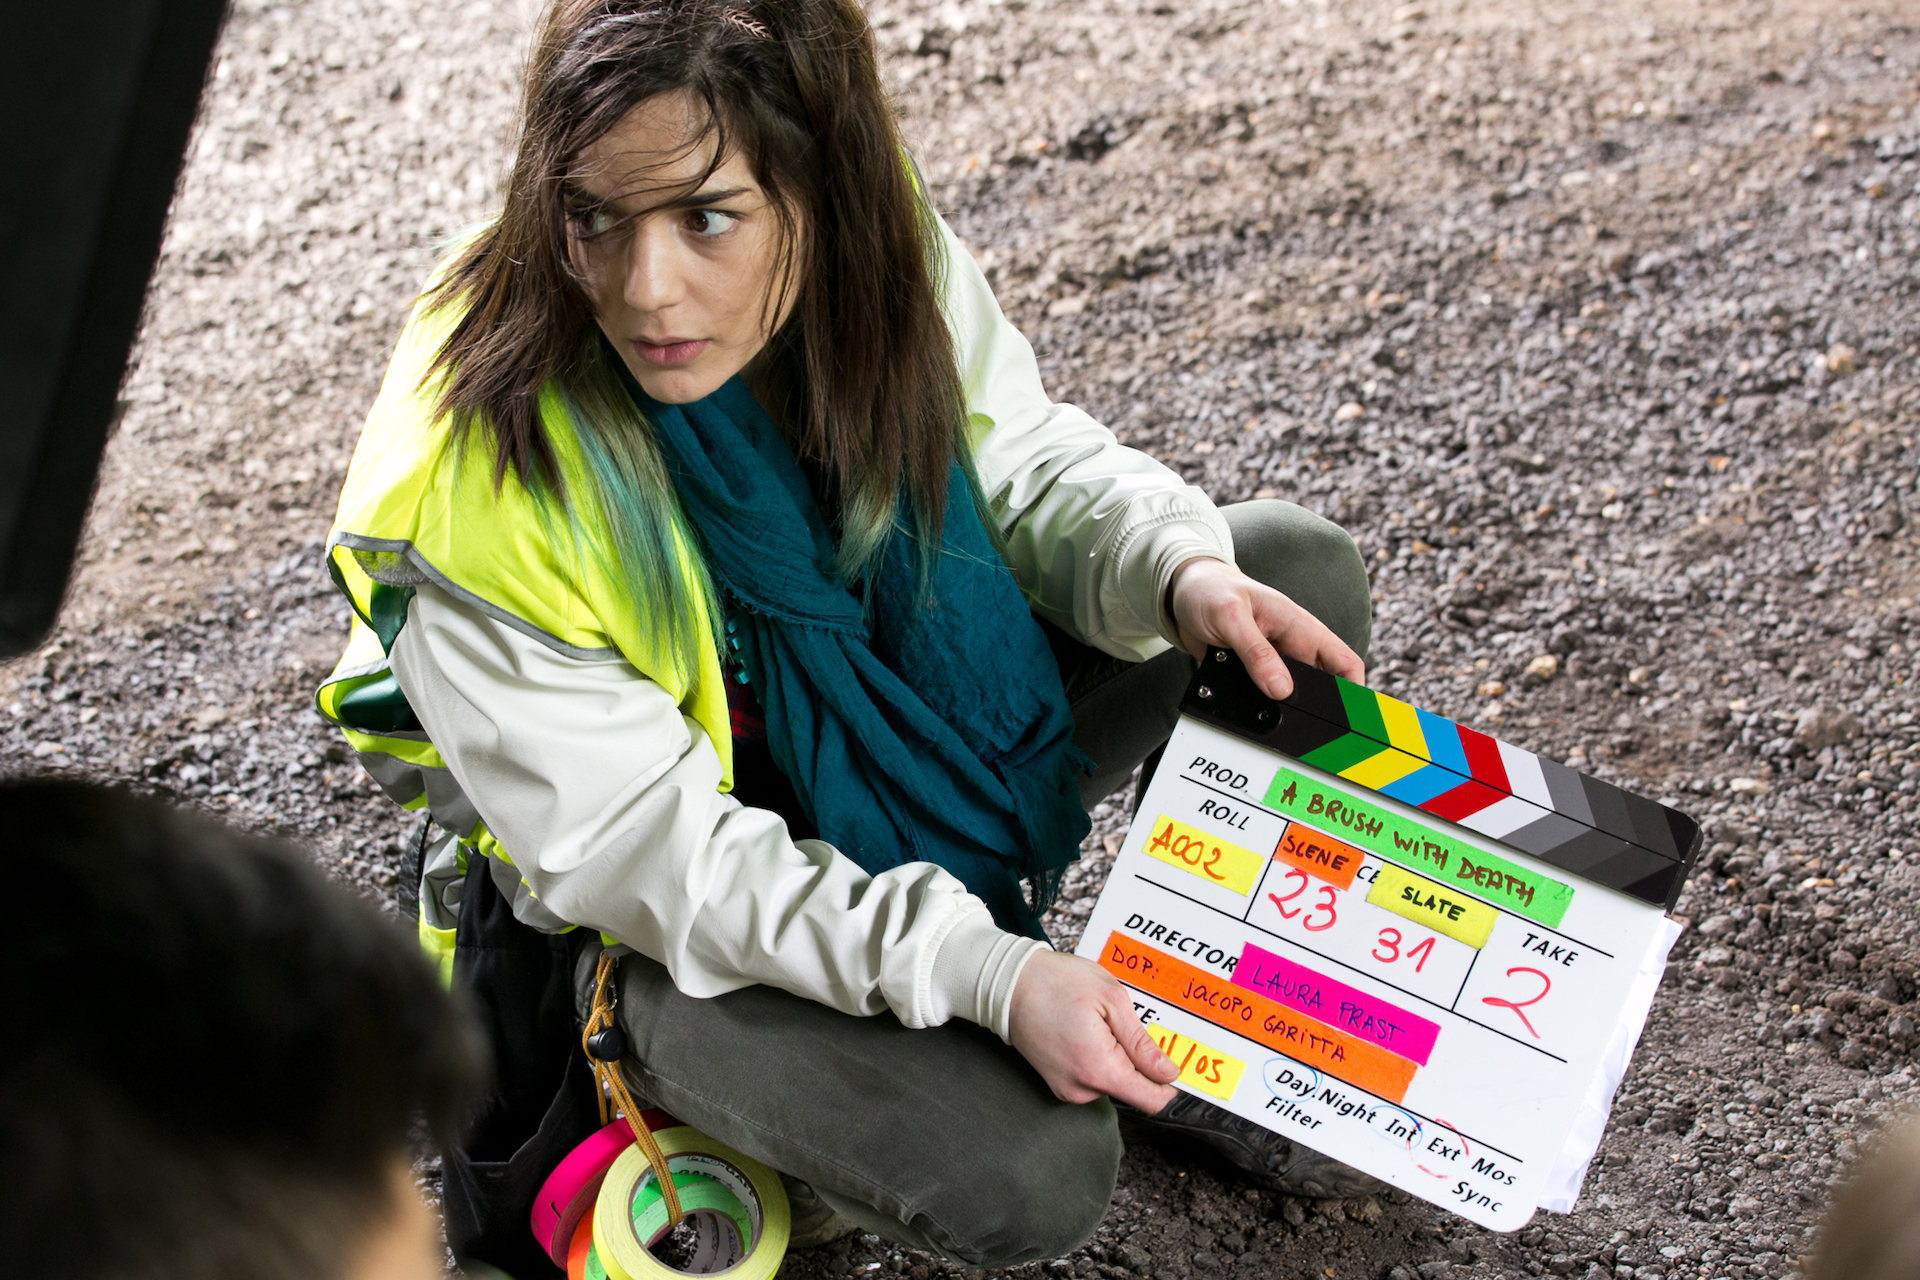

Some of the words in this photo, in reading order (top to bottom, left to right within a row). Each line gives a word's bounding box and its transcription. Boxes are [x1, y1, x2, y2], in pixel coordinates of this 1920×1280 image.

[1188, 756, 1249, 793] PROD.
[1198, 798, 1250, 831] ROLL
[1151, 822, 1226, 881] A002
[1279, 780, 1298, 806] A
[1306, 793, 1384, 839] BRUSH
[1456, 857, 1535, 908] DEATH
[1282, 834, 1350, 871] SCENE
[1267, 868, 1338, 932] 23
[1401, 885, 1467, 922] SLATE
[1110, 944, 1160, 980] DOP:
[1124, 913, 1240, 974] DIRECTOR
[1371, 927, 1436, 974] 31
[1521, 932, 1579, 967] TAKE
[1252, 964, 1325, 1010] LAURA
[1338, 1001, 1406, 1042] PRAST
[1482, 966, 1552, 1039] 2
[1265, 1095, 1323, 1130] Filter
[1318, 1088, 1377, 1124] Night
[1384, 1118, 1418, 1142] Int
[1426, 1136, 1462, 1161] Ext
[1471, 1157, 1517, 1187] Mos
[1452, 1180, 1503, 1213] Sync
